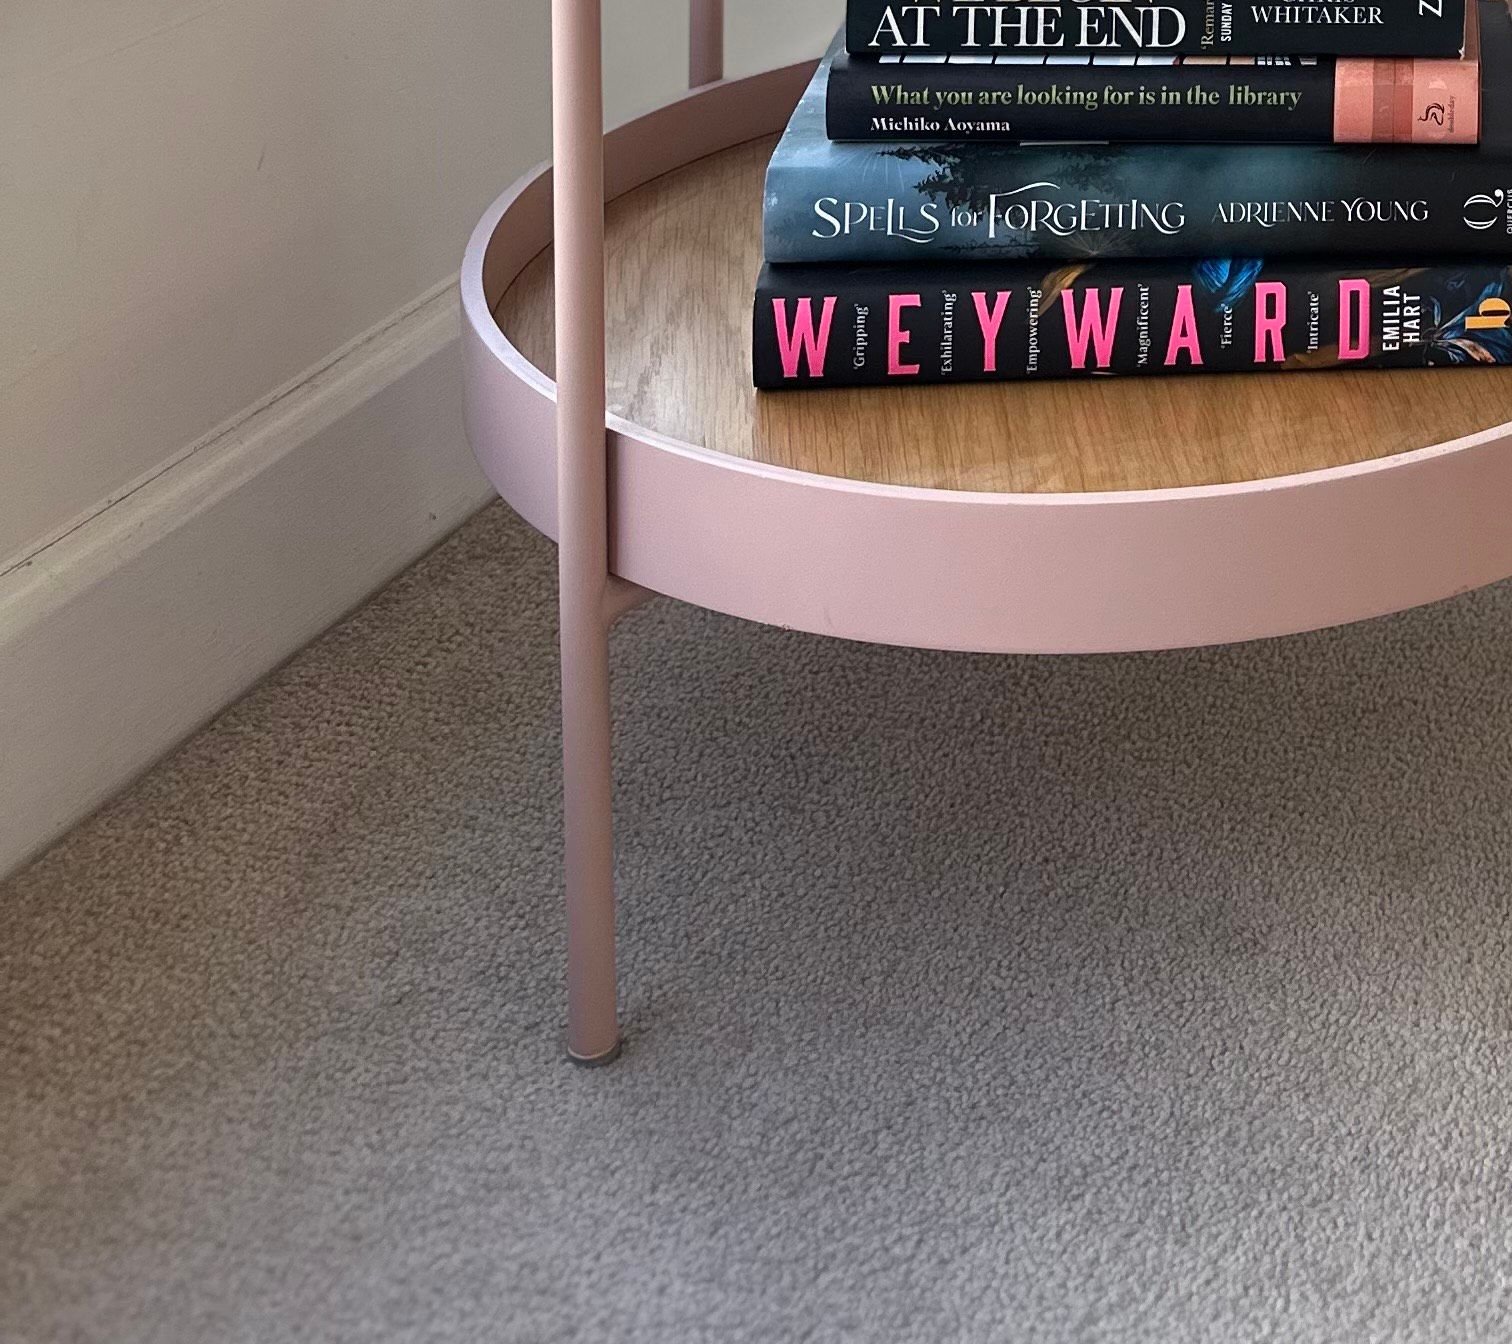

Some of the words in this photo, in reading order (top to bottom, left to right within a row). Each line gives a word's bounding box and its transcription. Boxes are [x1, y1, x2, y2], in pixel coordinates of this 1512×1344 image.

[867, 7, 943, 48] AT
[947, 7, 1065, 48] THE
[1077, 7, 1187, 48] END
[1221, 1, 1233, 42] SUNDAY
[1250, 6, 1385, 25] WHITAKER
[871, 84, 932, 106] What
[933, 87, 974, 110] you
[977, 87, 1013, 106] are
[1016, 83, 1099, 111] looking
[1101, 84, 1134, 110] for
[1135, 85, 1156, 106] is
[1160, 85, 1184, 106] in
[1186, 85, 1221, 106] the
[1228, 84, 1303, 111] library
[870, 116, 940, 133] Michiko
[943, 117, 1012, 135] Aoyama
[810, 196, 940, 244] SPELLS
[950, 200, 982, 229] for
[987, 181, 1186, 240] FORGETTING
[1211, 199, 1335, 228] ADRIENNE
[1340, 196, 1430, 224] YOUNG
[1381, 284, 1402, 352] EMILIA
[1403, 291, 1422, 344] HART
